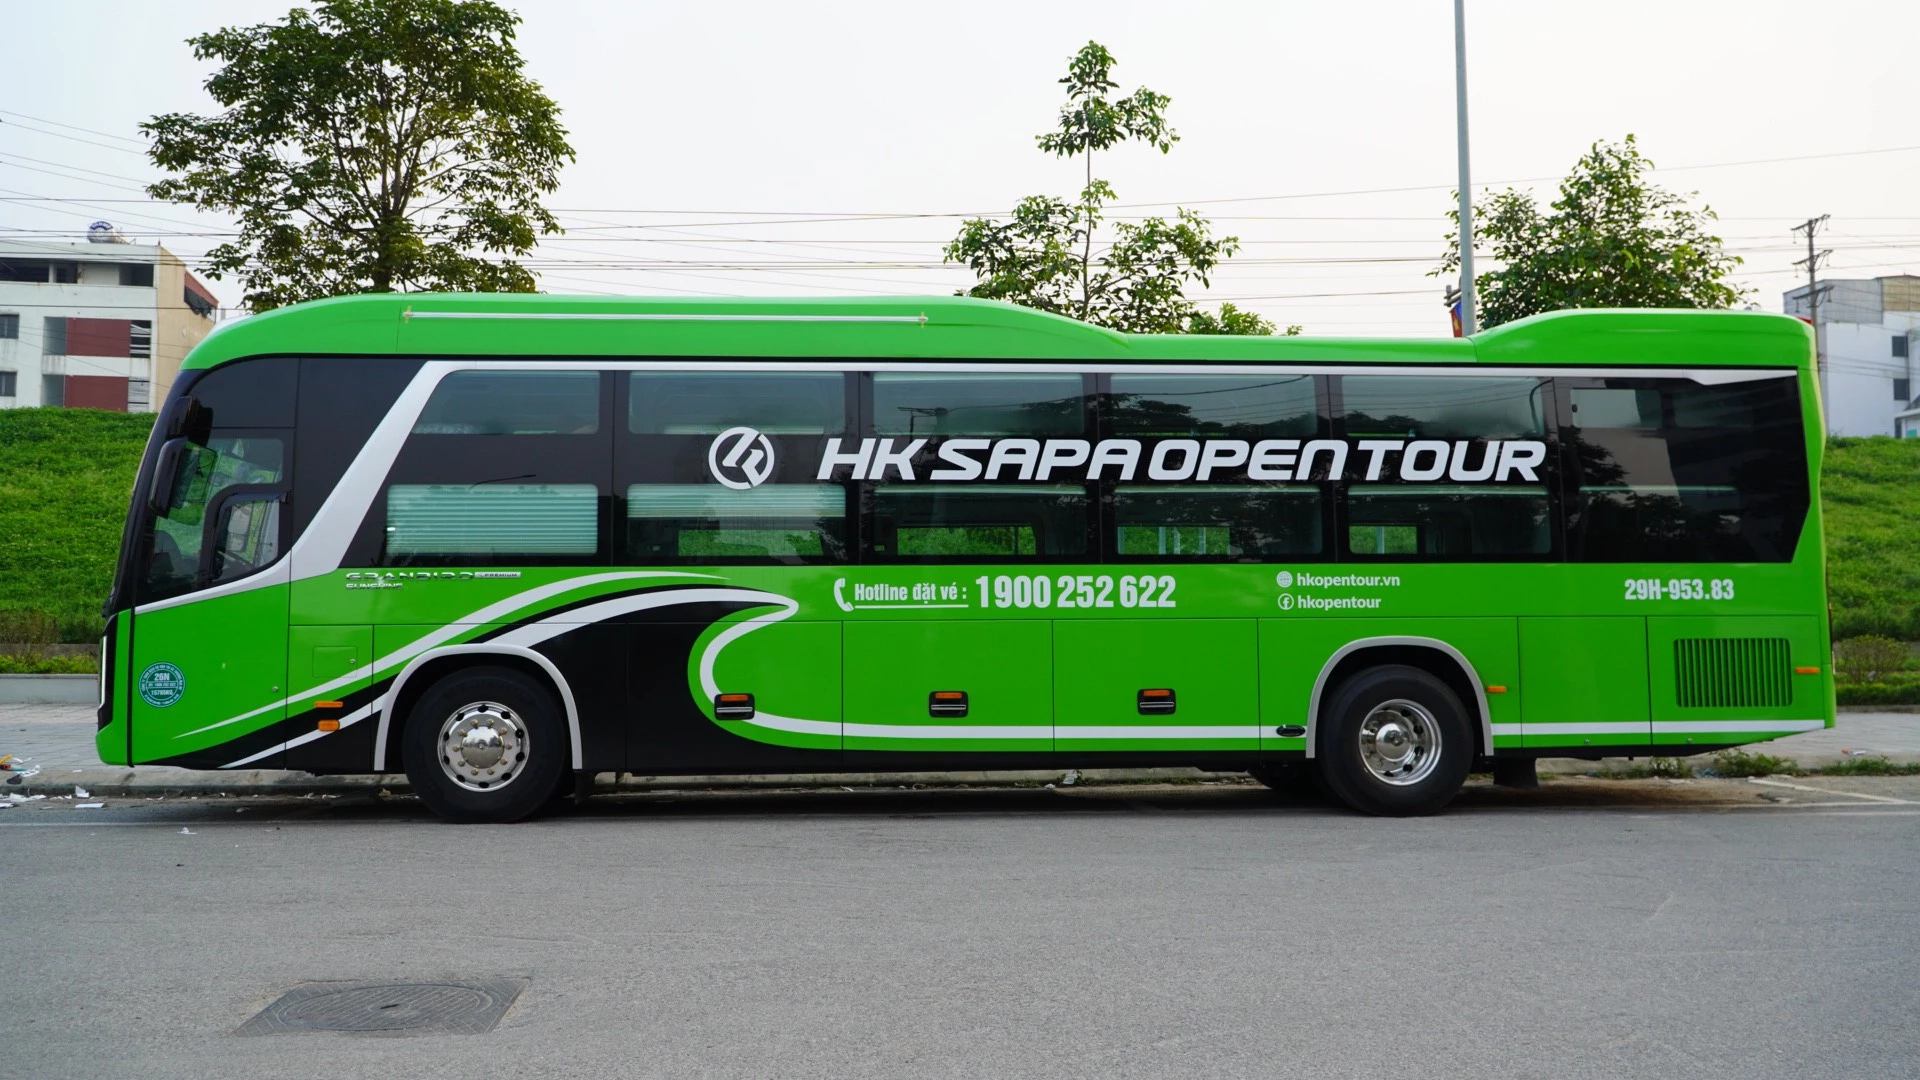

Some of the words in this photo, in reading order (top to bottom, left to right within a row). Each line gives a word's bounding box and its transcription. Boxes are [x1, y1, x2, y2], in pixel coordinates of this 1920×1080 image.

[816, 438, 928, 480] HK
[930, 438, 1142, 481] SAPA
[1147, 439, 1349, 481] OPEN
[1357, 440, 1546, 482] TOUR
[1296, 572, 1401, 589] hkopentour.vn
[1624, 578, 1735, 601] 29H-953.83
[854, 584, 908, 601] Hotline
[912, 582, 937, 604] đặt
[975, 575, 1052, 608] 1900
[1057, 575, 1115, 608] 252
[1119, 575, 1177, 608] 622
[1297, 595, 1382, 611] hkopentour
[154, 672, 170, 681] 26N
